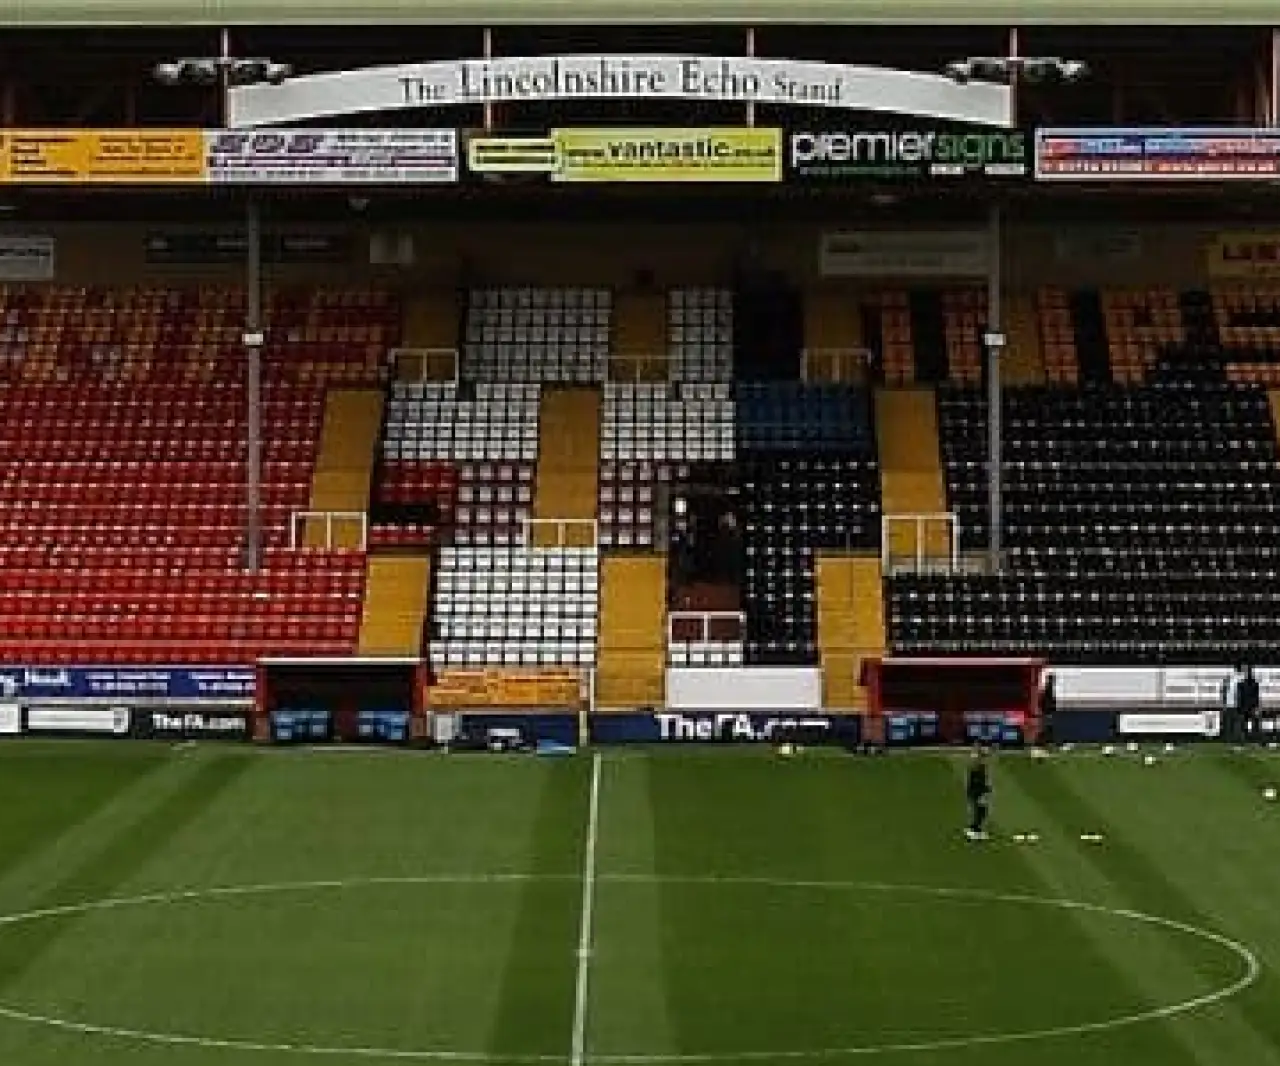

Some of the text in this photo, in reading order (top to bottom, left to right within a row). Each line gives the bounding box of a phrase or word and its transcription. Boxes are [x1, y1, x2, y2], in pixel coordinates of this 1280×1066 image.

[399, 57, 842, 104] The Lincolnshire Echo Stand
[151, 713, 248, 734] TheFA.com
